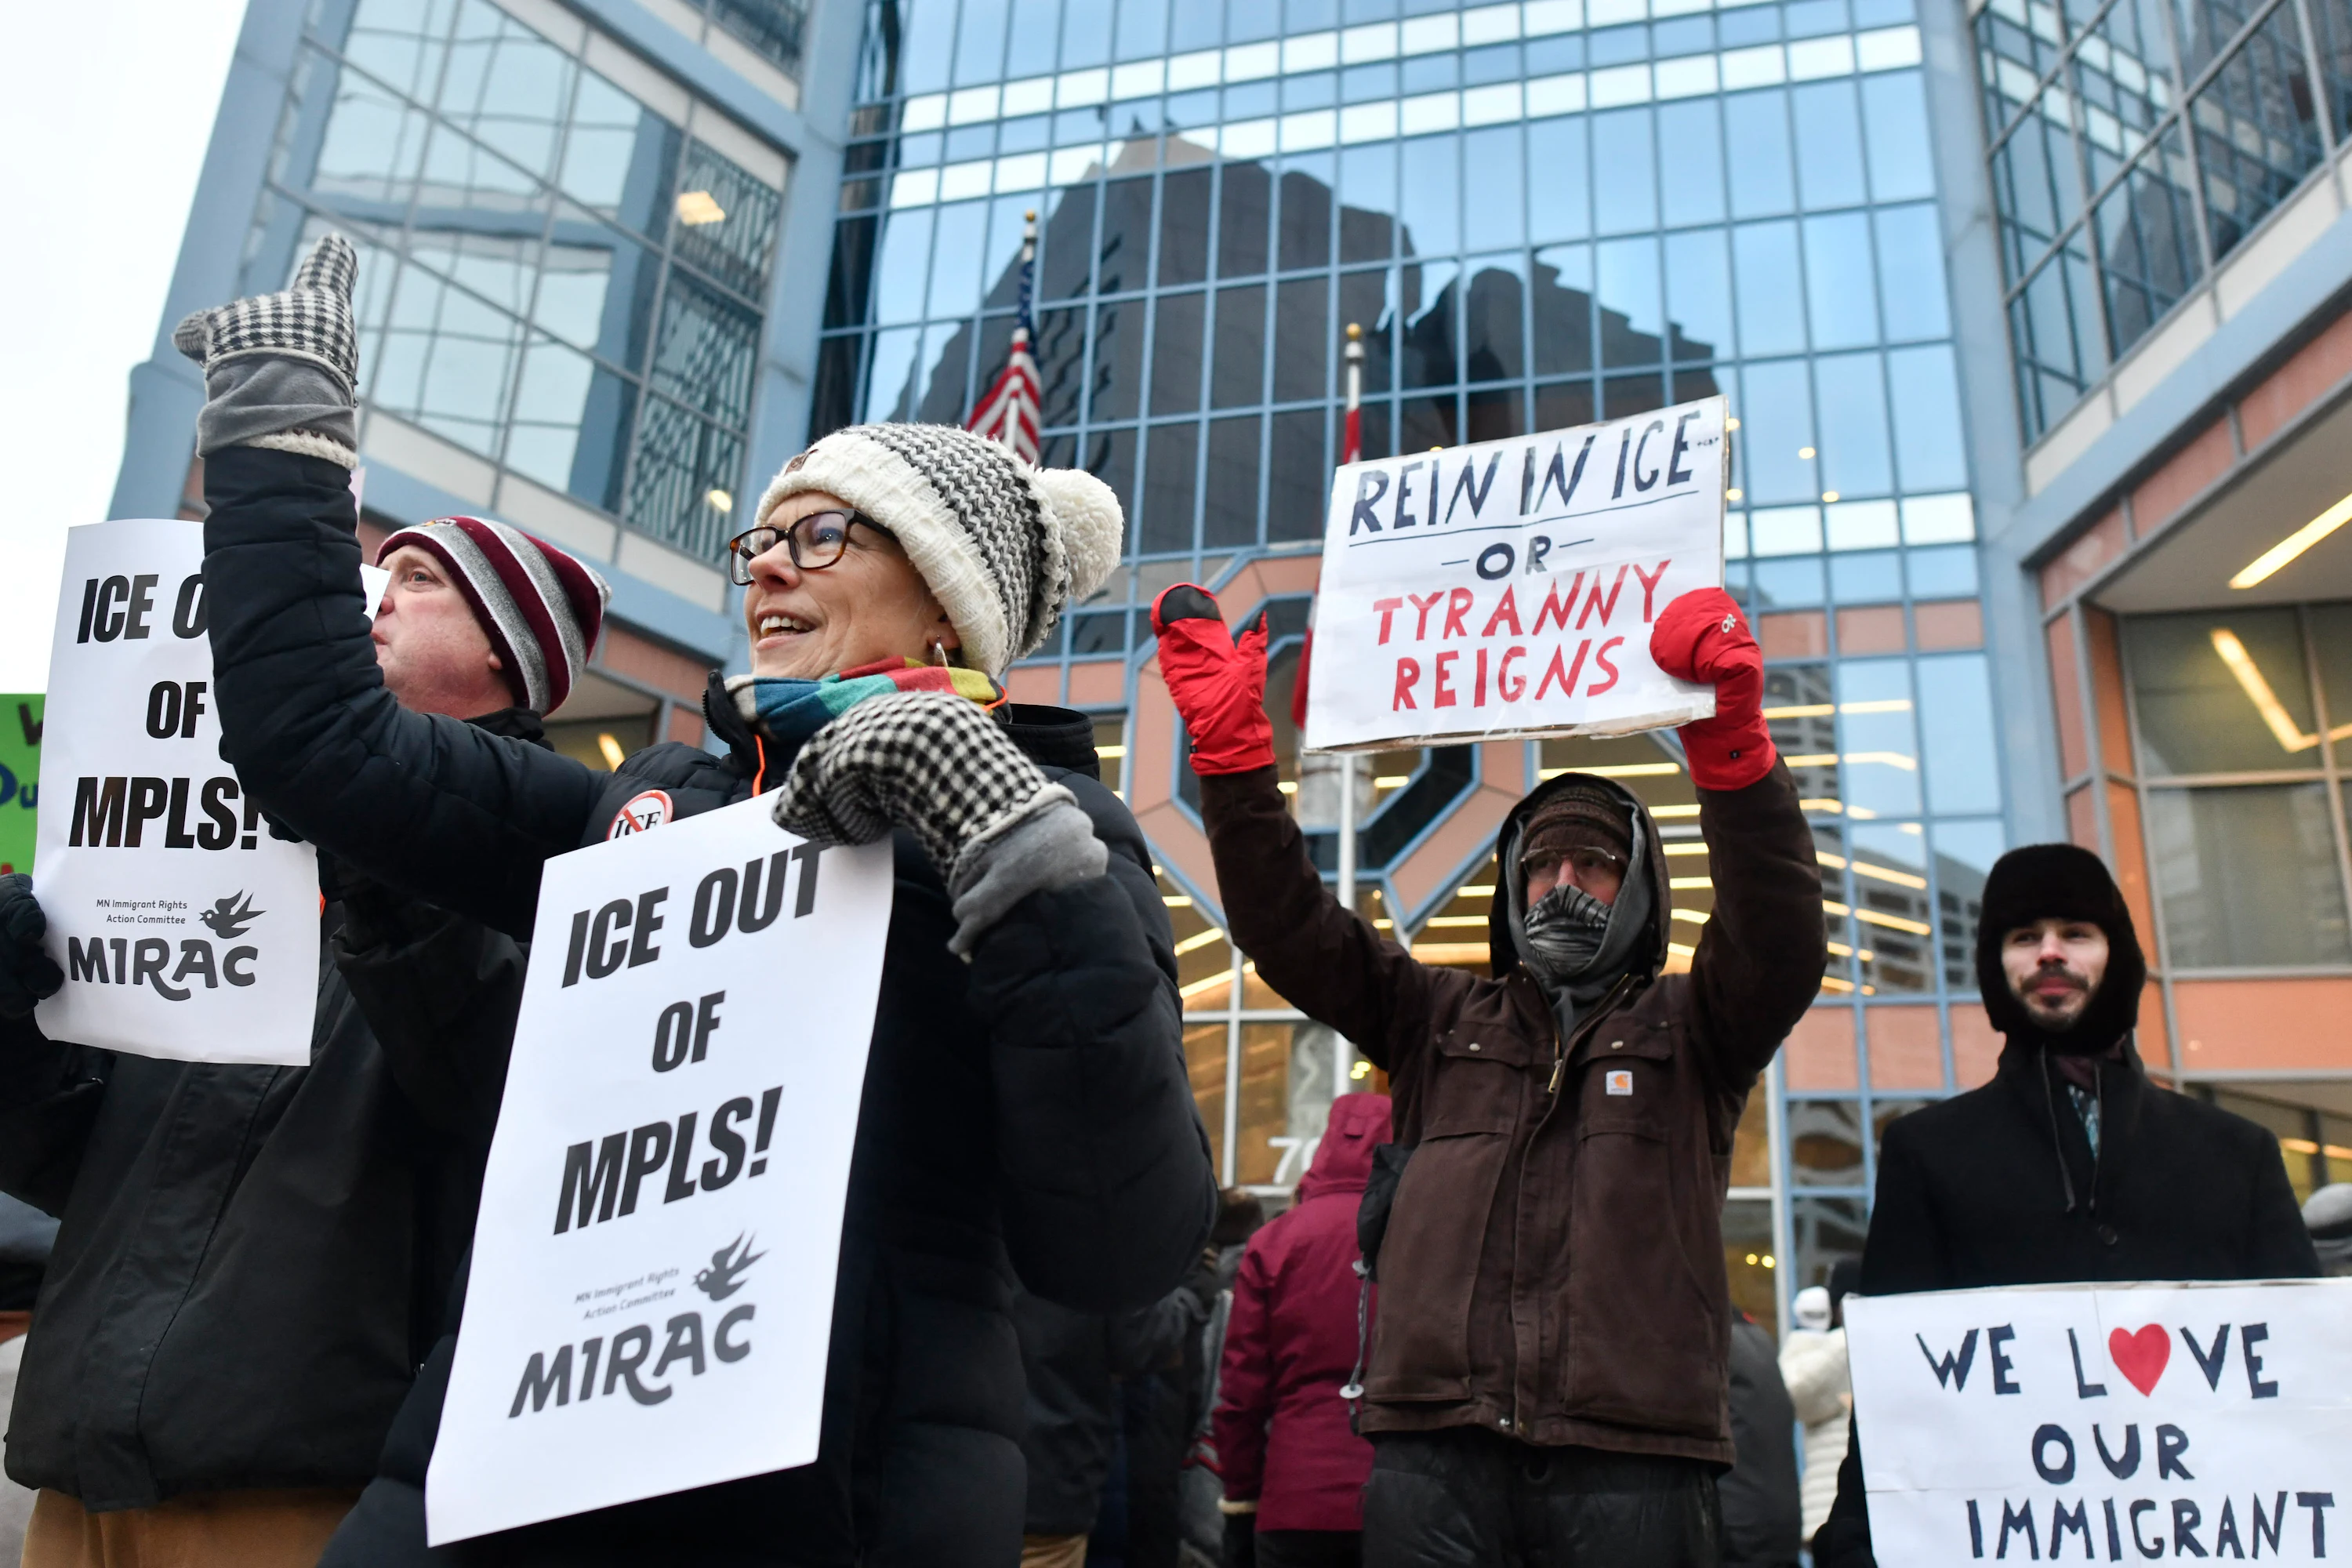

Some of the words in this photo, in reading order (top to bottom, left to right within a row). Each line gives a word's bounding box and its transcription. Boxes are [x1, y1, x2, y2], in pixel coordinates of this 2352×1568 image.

[1349, 450, 1503, 535] REIN
[1519, 435, 1596, 516] IN
[1612, 410, 1700, 500] ICE
[1475, 535, 1552, 581] OR
[77, 575, 158, 644] ICE
[1373, 559, 1671, 645] TYRANNY
[146, 681, 207, 739] OF
[1392, 636, 1624, 712] REIGNS
[68, 776, 259, 851] MPLS!
[96, 899, 111, 908] MN
[112, 899, 156, 911] Immigrant
[158, 900, 188, 912] Rights
[106, 914, 135, 924] Action
[137, 914, 186, 924] Committee
[561, 886, 670, 989] ICE
[689, 840, 833, 949] OUT
[652, 989, 726, 1073] OF
[553, 1086, 783, 1236] MPLS!
[583, 1305, 617, 1320] Action
[619, 1288, 677, 1310] Committee
[594, 1276, 644, 1296] Immigrant
[647, 1268, 680, 1285] Rights
[1916, 1323, 2021, 1395] WE
[2032, 1423, 2195, 1485] OUR
[1966, 1491, 2335, 1563] IMMIGRANT
